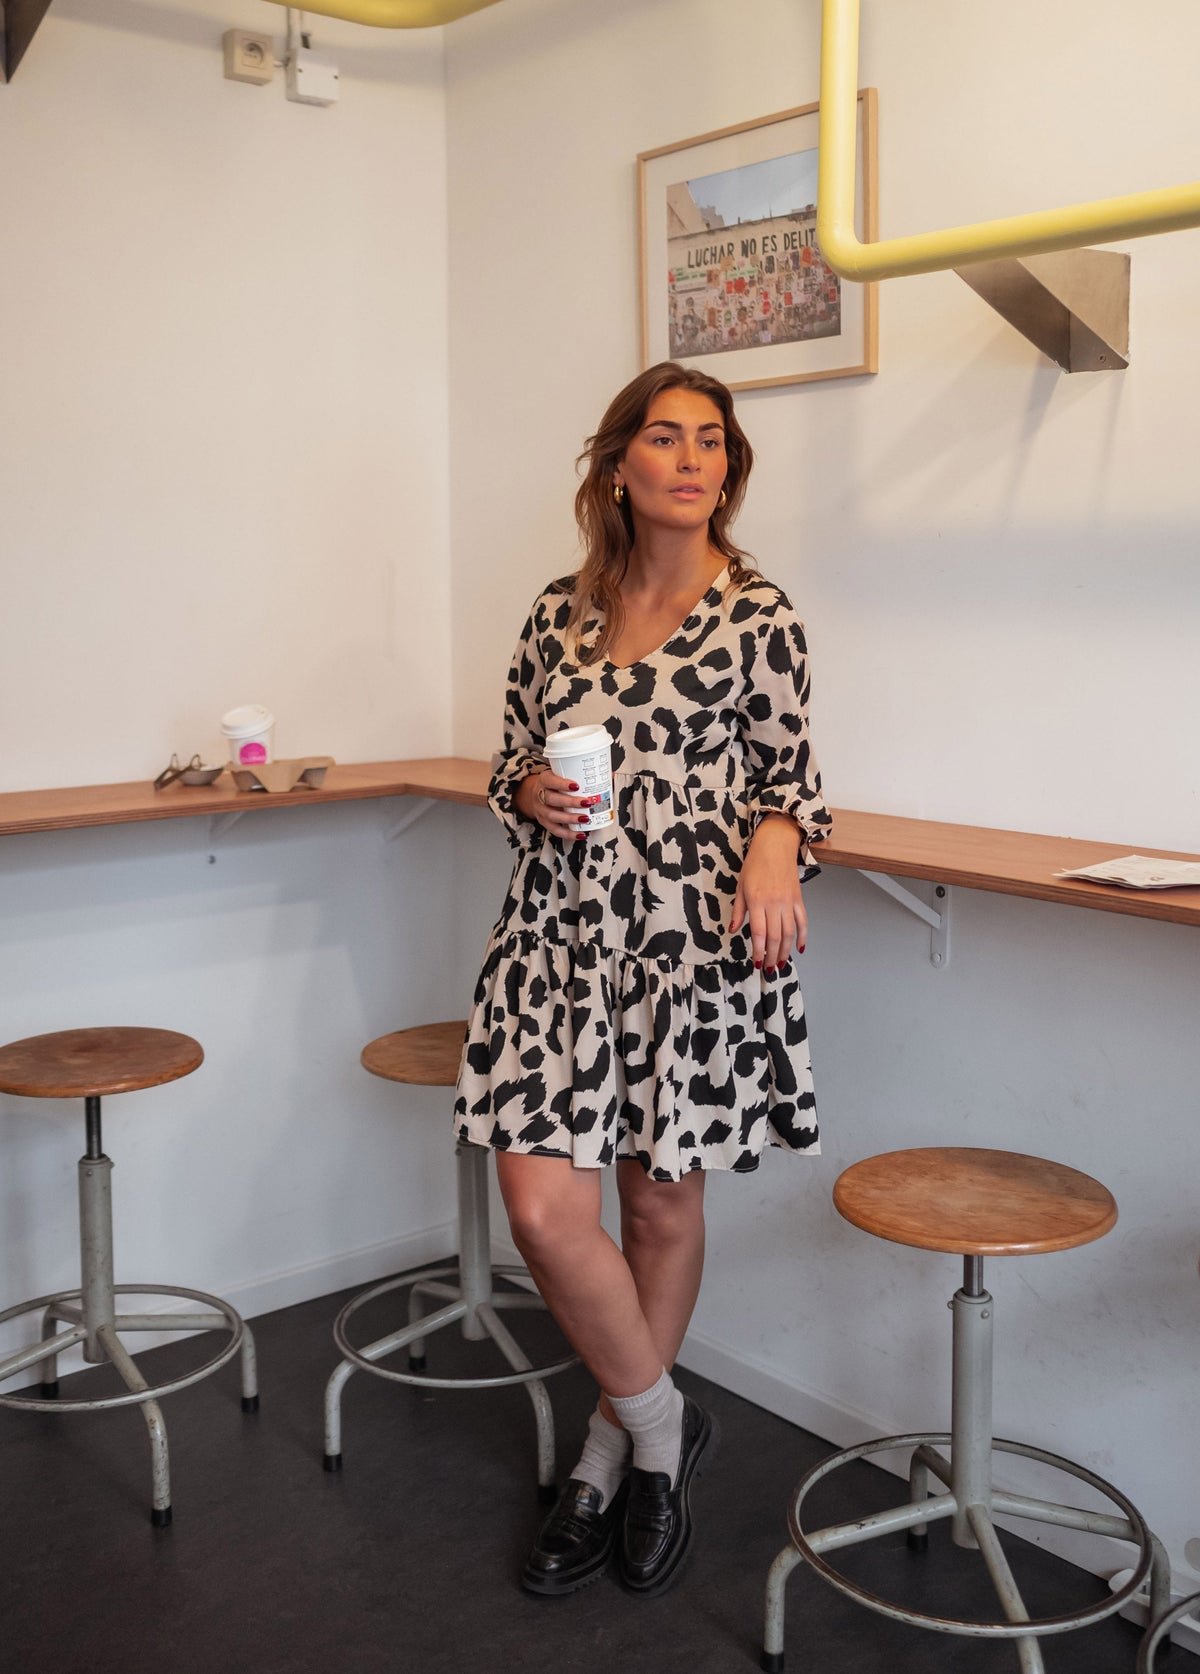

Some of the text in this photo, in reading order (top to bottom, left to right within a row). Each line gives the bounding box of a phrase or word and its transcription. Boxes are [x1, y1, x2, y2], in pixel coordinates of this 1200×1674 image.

[687, 228, 816, 269] LUCHAR NO ES DELIT
